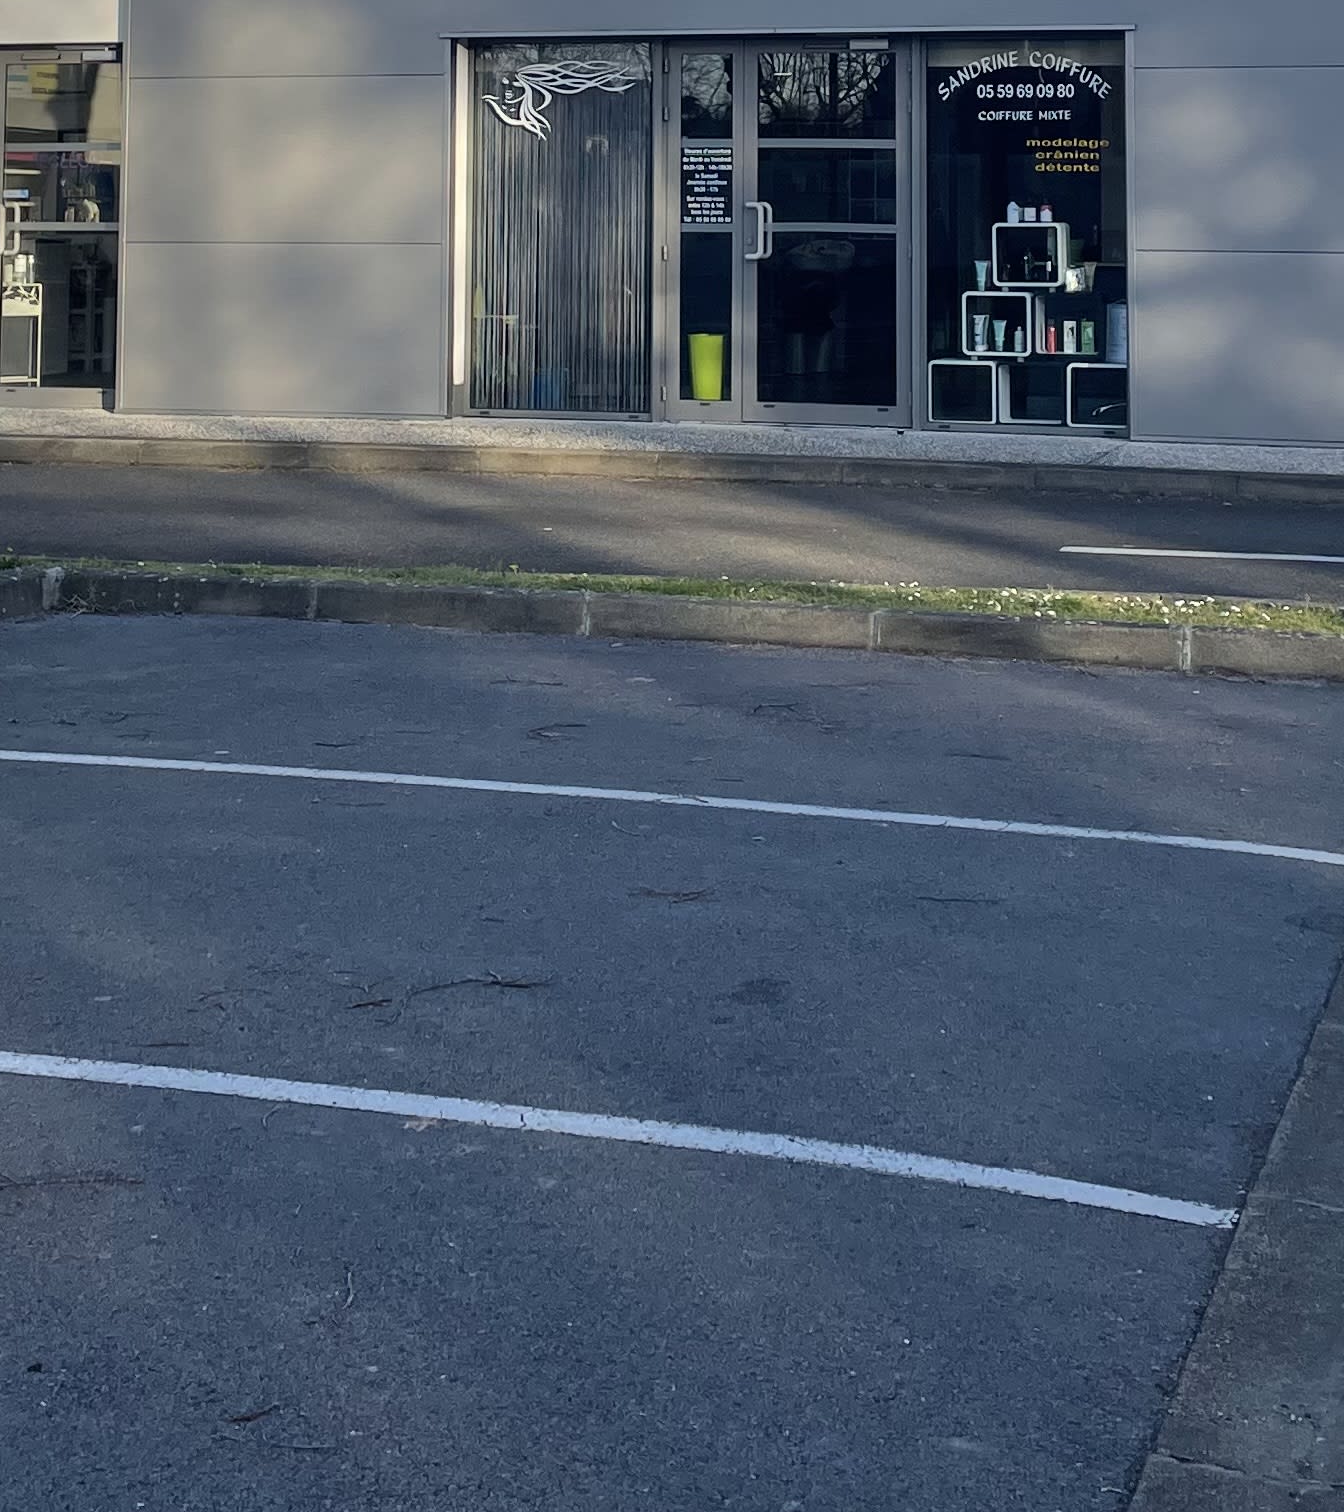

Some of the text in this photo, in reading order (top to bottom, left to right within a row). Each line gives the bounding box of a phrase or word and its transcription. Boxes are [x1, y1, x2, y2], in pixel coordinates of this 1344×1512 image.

[938, 51, 1113, 102] SANDRINE COIFFURE
[976, 83, 1075, 99] 05 59 69 09 80
[977, 109, 1072, 121] COIFFURE MIXTE
[1025, 138, 1110, 149] modelage
